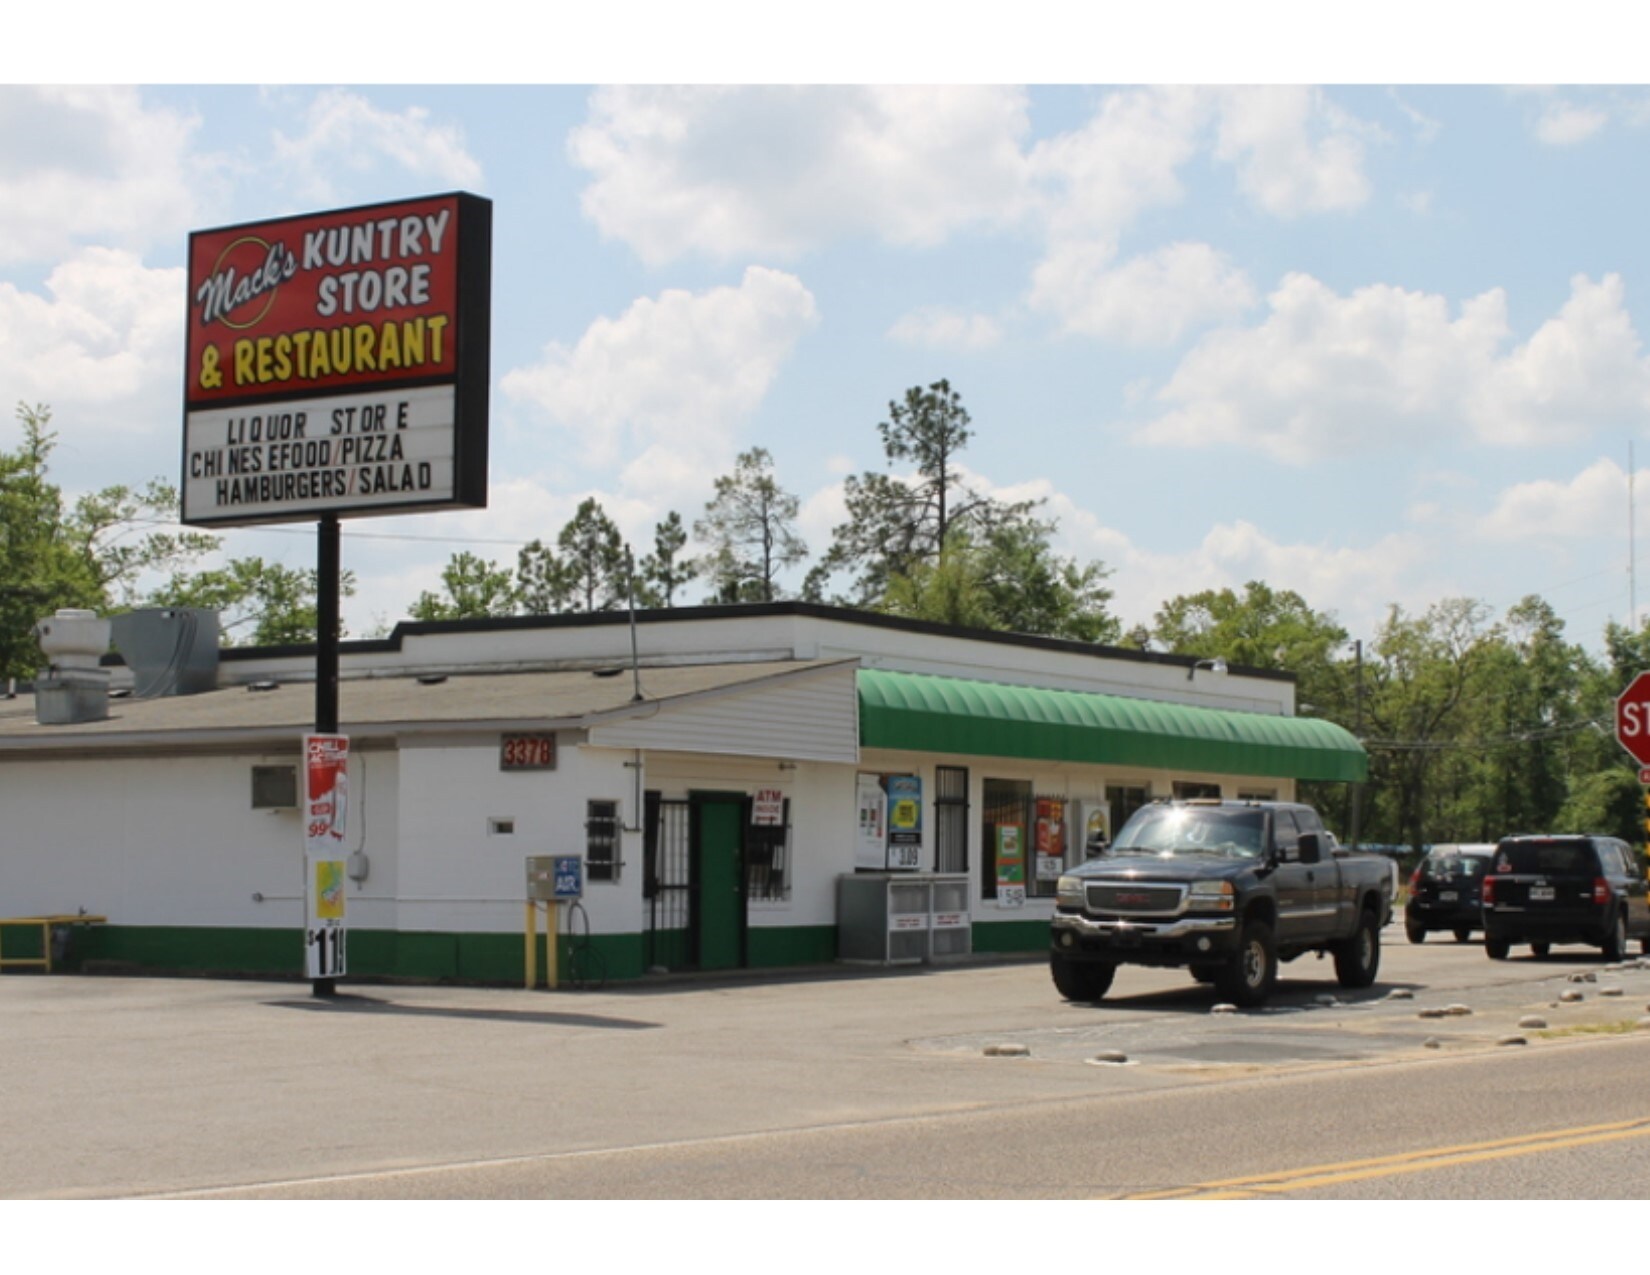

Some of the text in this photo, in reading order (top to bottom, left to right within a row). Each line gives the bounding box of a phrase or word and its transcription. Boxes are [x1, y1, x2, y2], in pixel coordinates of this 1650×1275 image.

[196, 209, 450, 322] Mack's KUNTRY
[316, 264, 431, 317] STORE
[200, 315, 448, 389] & RESTAURANT
[227, 411, 308, 445] LIQUOR
[756, 788, 782, 802] ATM
